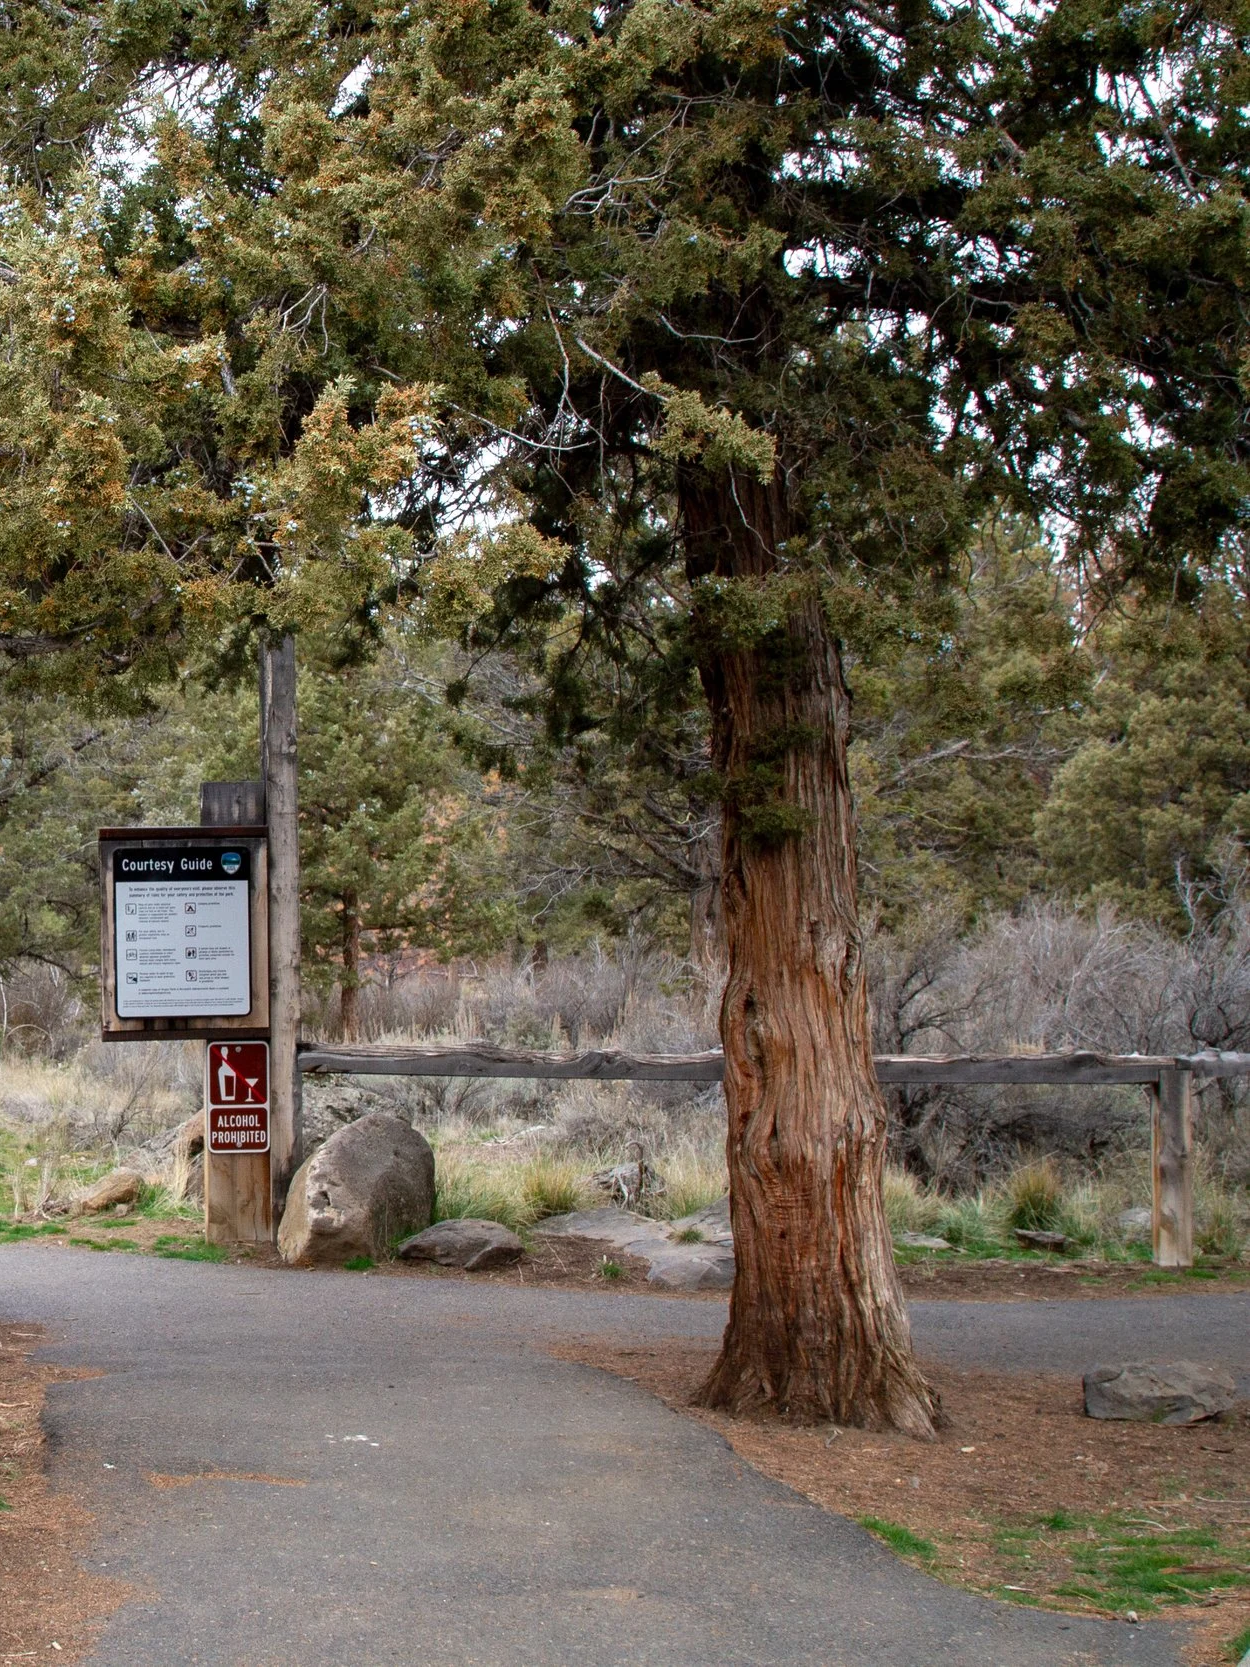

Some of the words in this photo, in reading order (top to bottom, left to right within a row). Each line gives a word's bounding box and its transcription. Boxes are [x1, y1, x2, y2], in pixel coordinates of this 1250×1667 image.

[122, 859, 174, 873] Courtesy
[181, 858, 213, 870] Guide
[217, 1115, 261, 1127] ALCOHOL
[211, 1130, 266, 1143] PROHIBITED
